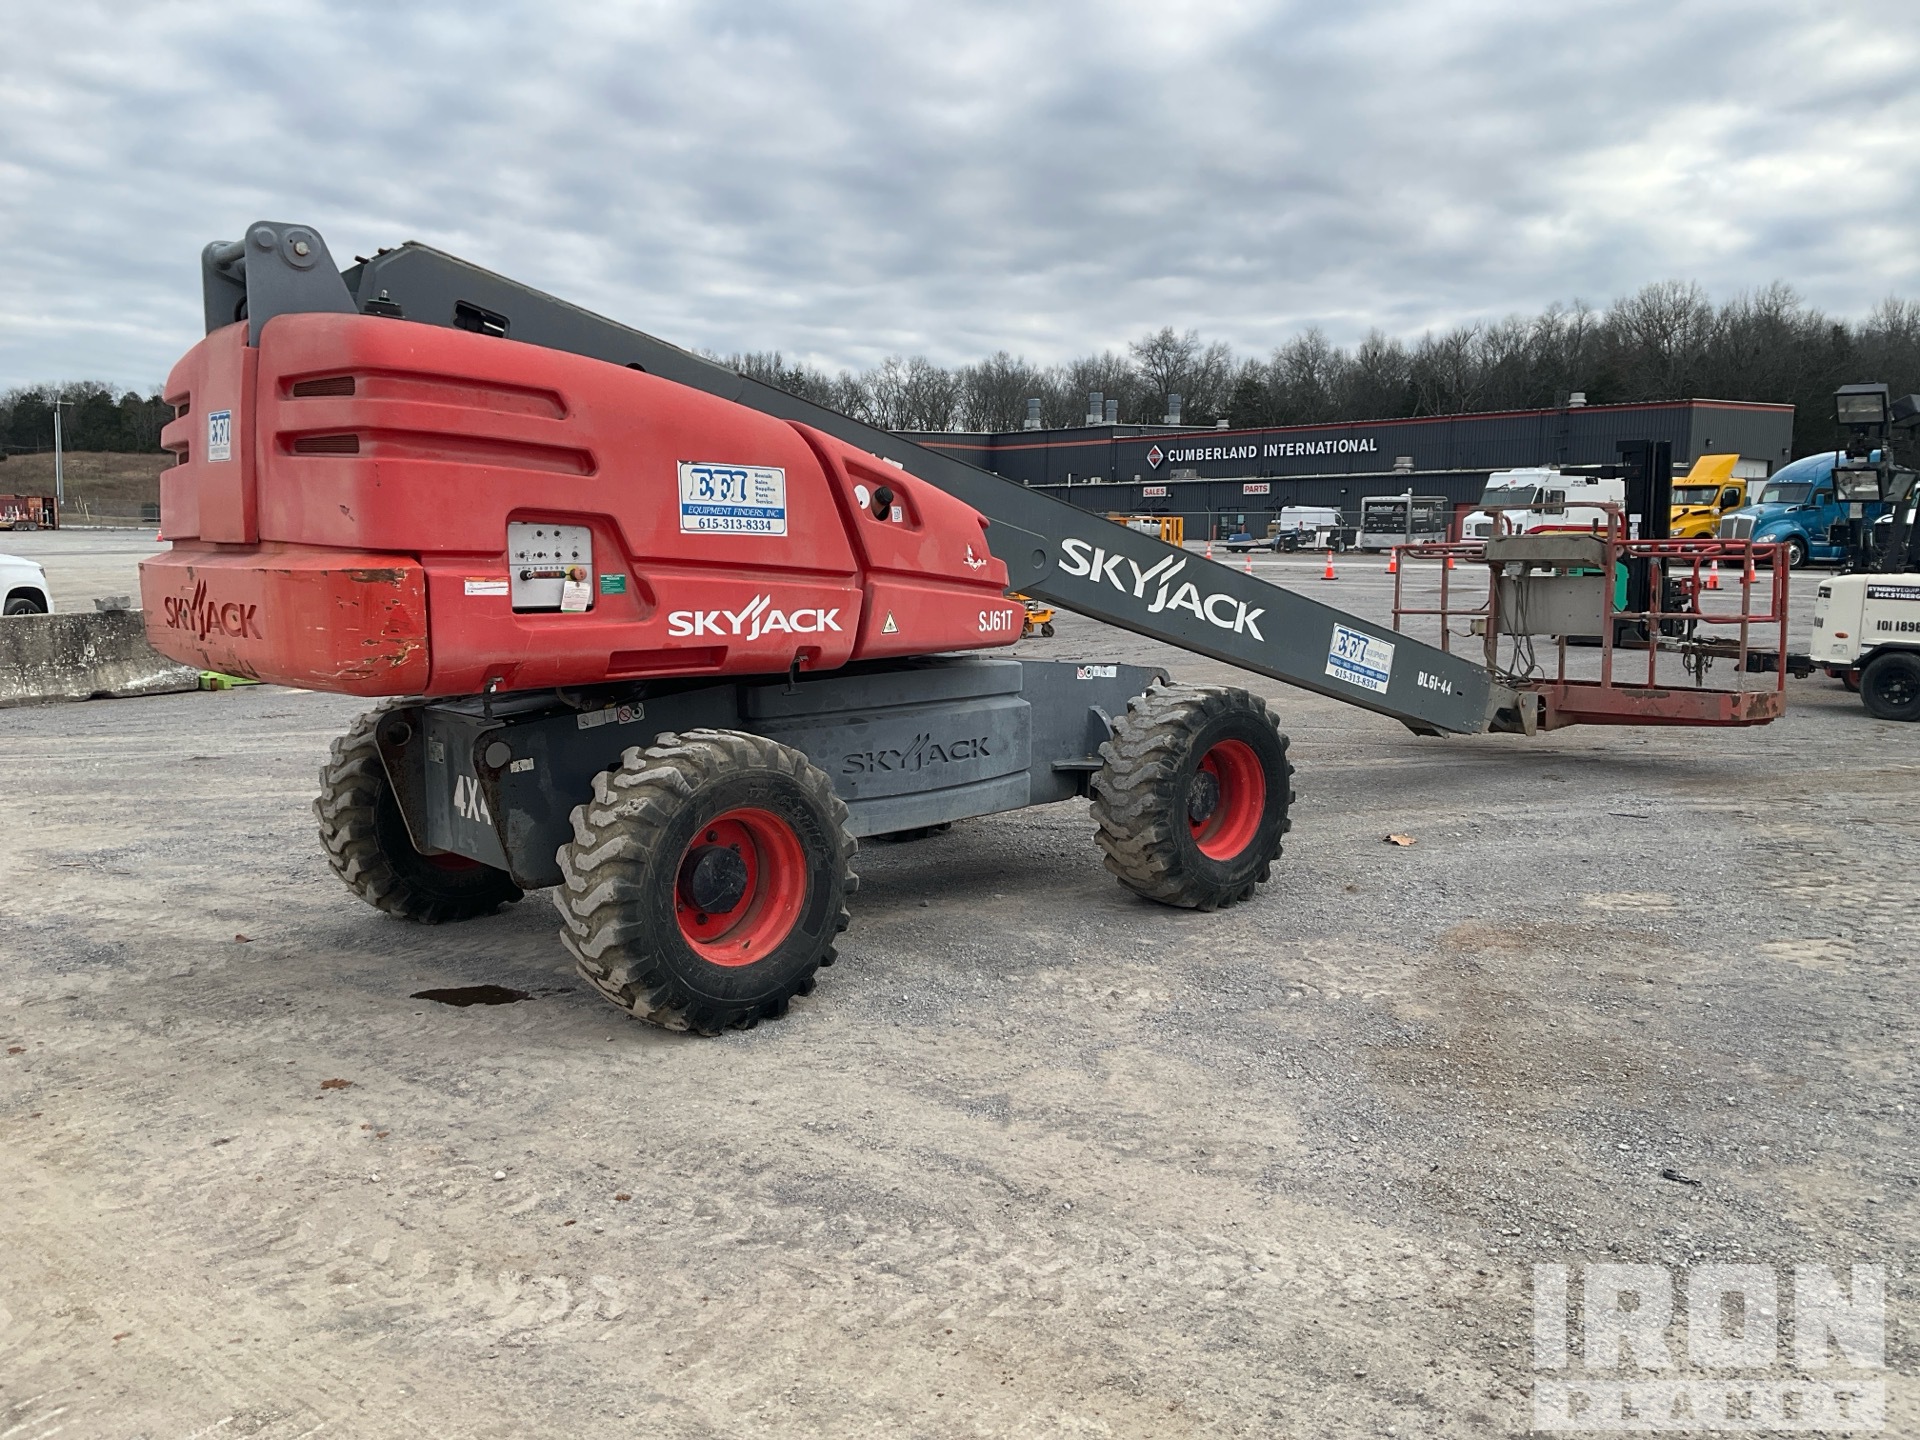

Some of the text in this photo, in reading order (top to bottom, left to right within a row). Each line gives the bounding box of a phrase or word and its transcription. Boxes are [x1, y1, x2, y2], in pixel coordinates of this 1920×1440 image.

[1168, 438, 1377, 462] CUMBERLAND INTERNATIONAL
[689, 468, 748, 503] EFI
[1144, 488, 1165, 496] SALES
[1245, 485, 1268, 493] PARTS
[688, 506, 731, 515] EQUIPMENT
[733, 508, 765, 517] FINDERS,
[698, 517, 771, 531] 615-313-8334
[1058, 538, 1265, 642] SKYJACK
[164, 578, 262, 641] SKYJACK
[668, 594, 843, 641] SKYJACK
[978, 609, 1013, 632] SJ61T
[1332, 629, 1369, 662] EFI
[1334, 668, 1378, 690] 615-313-8334
[841, 732, 991, 775] SKYJACK
